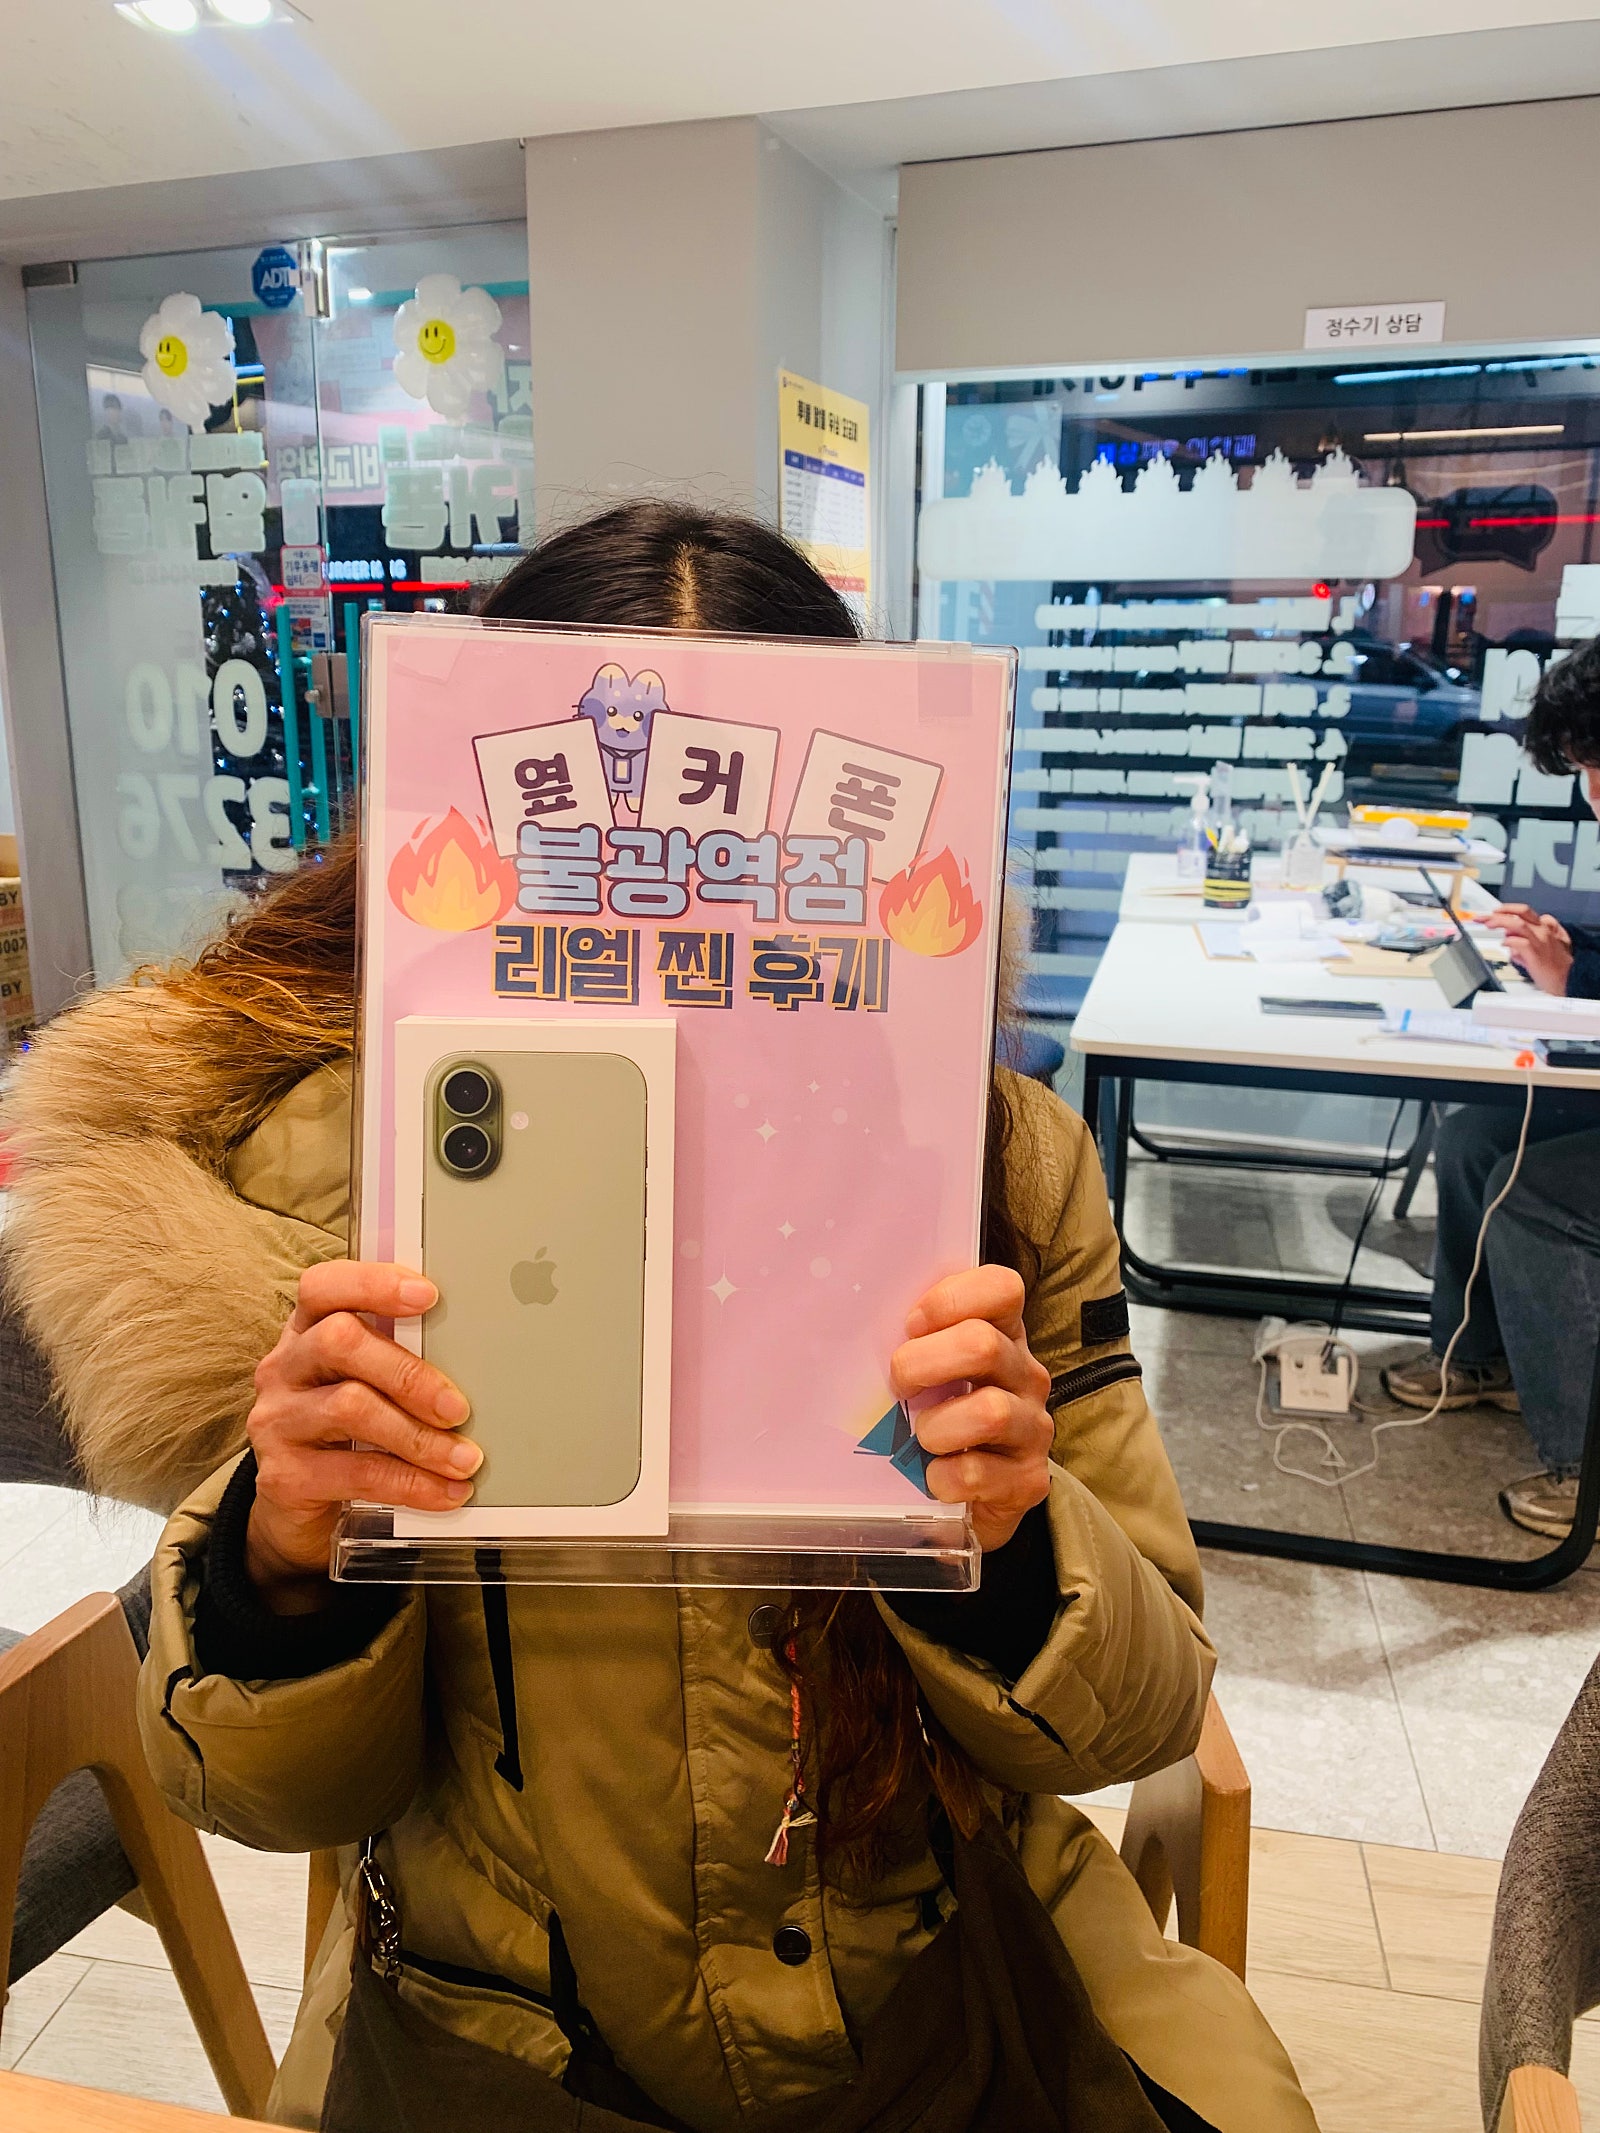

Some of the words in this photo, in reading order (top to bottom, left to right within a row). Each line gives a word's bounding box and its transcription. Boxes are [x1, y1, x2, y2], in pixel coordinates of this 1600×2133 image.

[1326, 315, 1380, 338] 정수기
[1385, 312, 1424, 335] 상담
[514, 821, 870, 926] 불광역점
[491, 921, 640, 1006] 리얼
[653, 927, 734, 1010] 찐
[747, 934, 891, 1013] 후기
